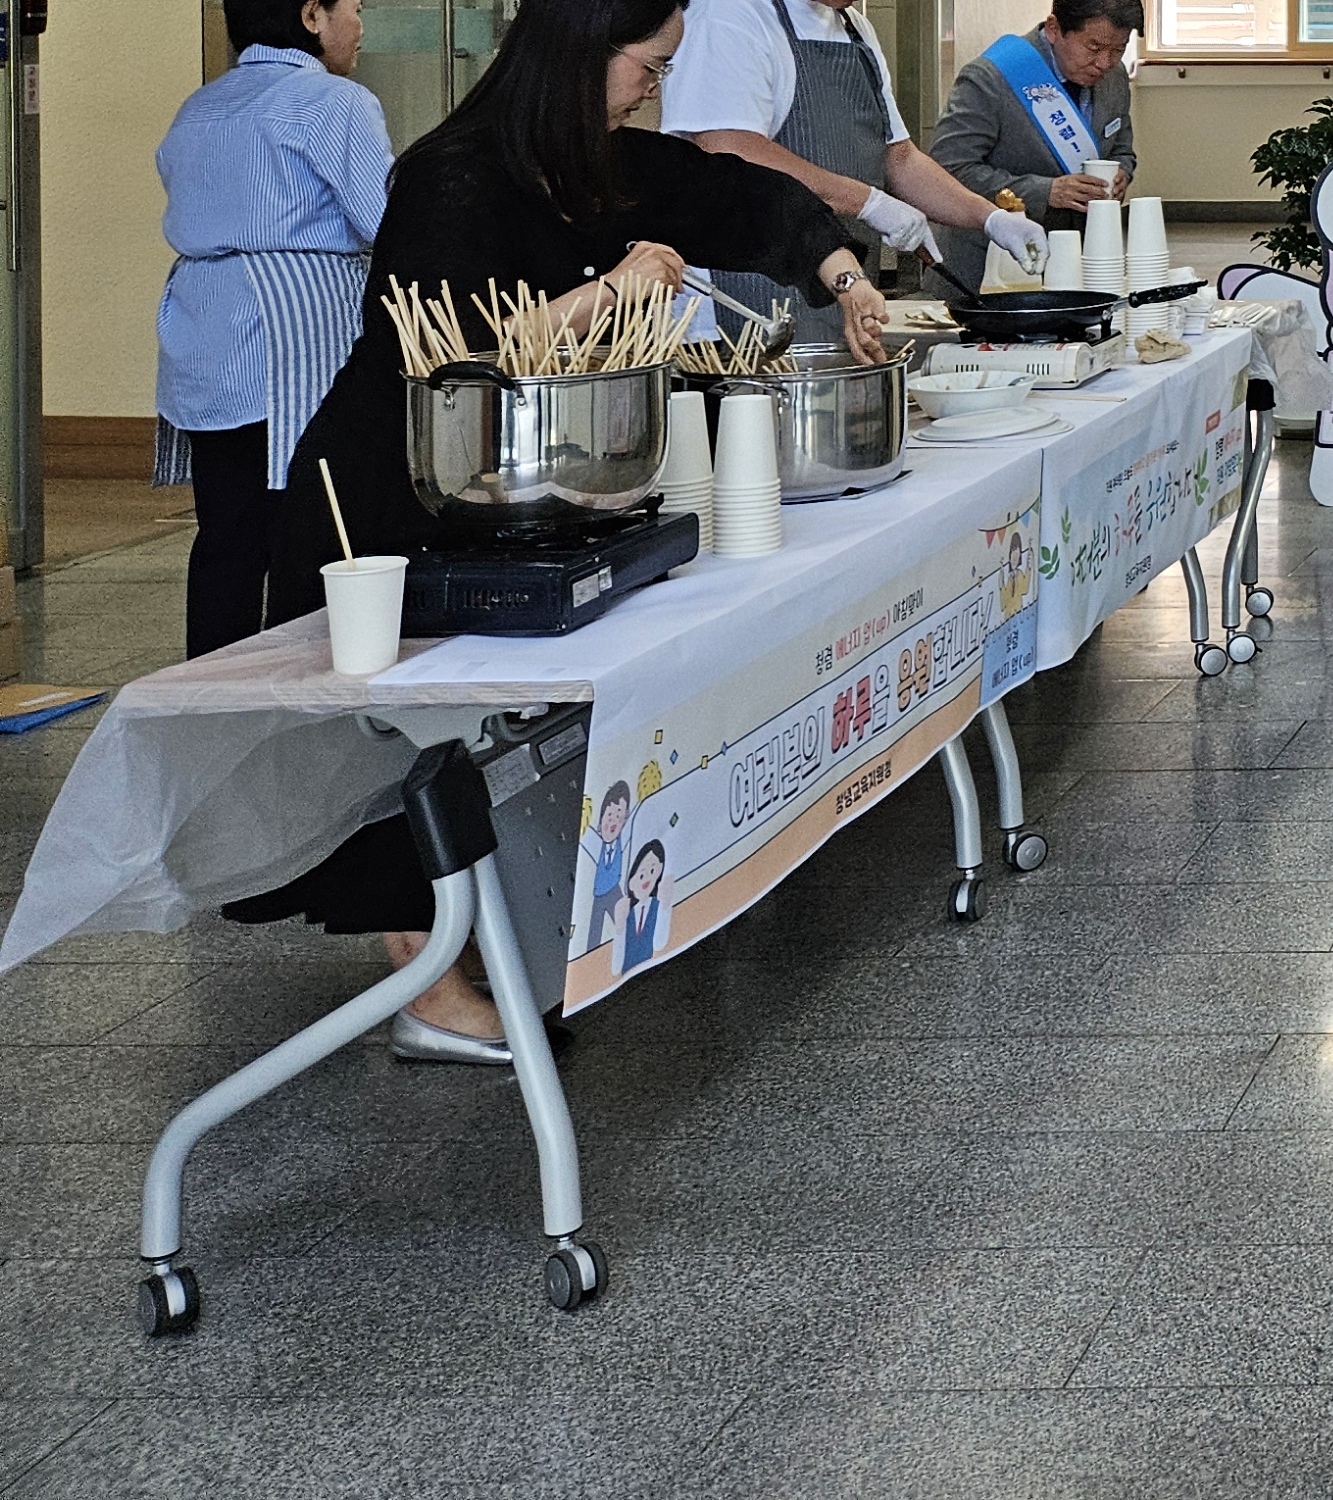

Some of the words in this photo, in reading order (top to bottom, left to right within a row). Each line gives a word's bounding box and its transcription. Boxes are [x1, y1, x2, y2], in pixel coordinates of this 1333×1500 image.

[816, 644, 833, 675] 청렴
[836, 627, 860, 660] 에너지
[893, 587, 923, 623] 아침맞이
[729, 706, 825, 827] 여러분의
[836, 758, 891, 815] 창녕교육지원청
